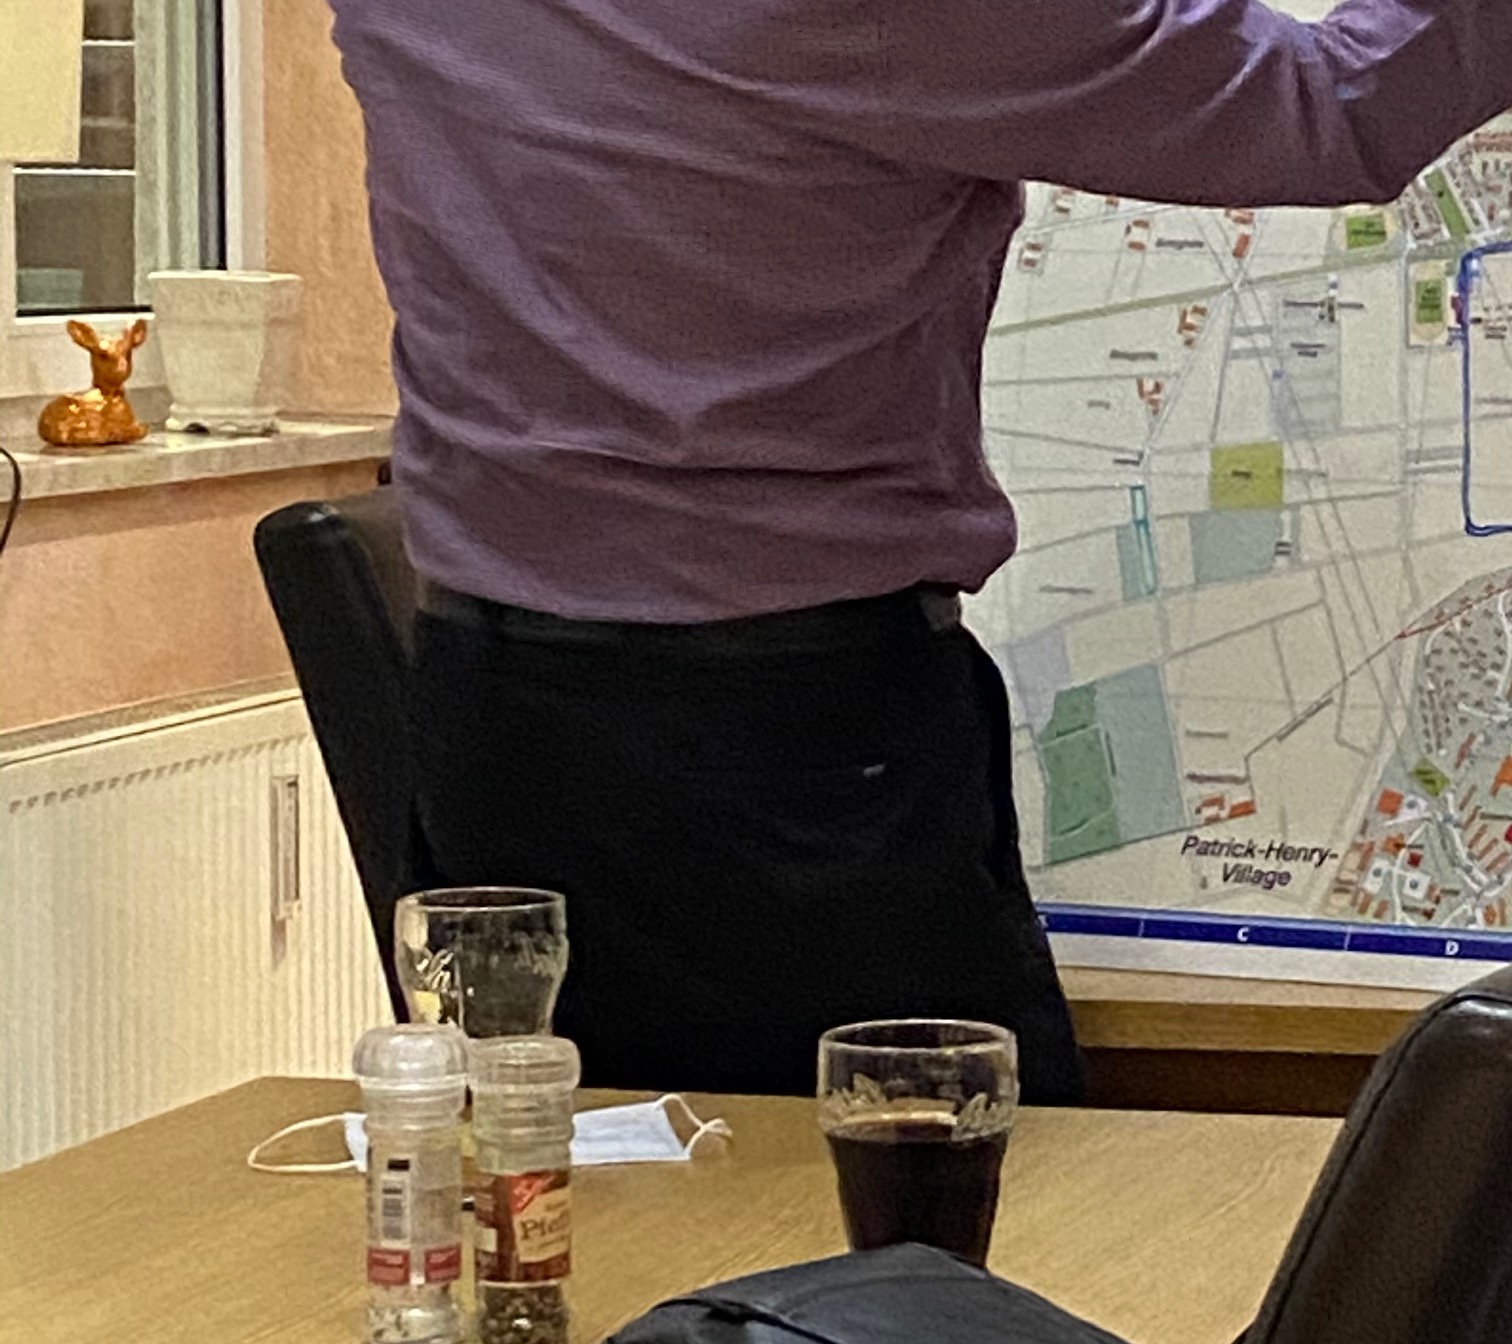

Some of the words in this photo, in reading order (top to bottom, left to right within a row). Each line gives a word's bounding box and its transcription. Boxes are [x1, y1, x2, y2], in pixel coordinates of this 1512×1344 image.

[1180, 834, 1339, 869] Patrick-Henry-
[1222, 861, 1292, 891] Village
[1237, 926, 1250, 943] C
[1445, 939, 1461, 957] D
